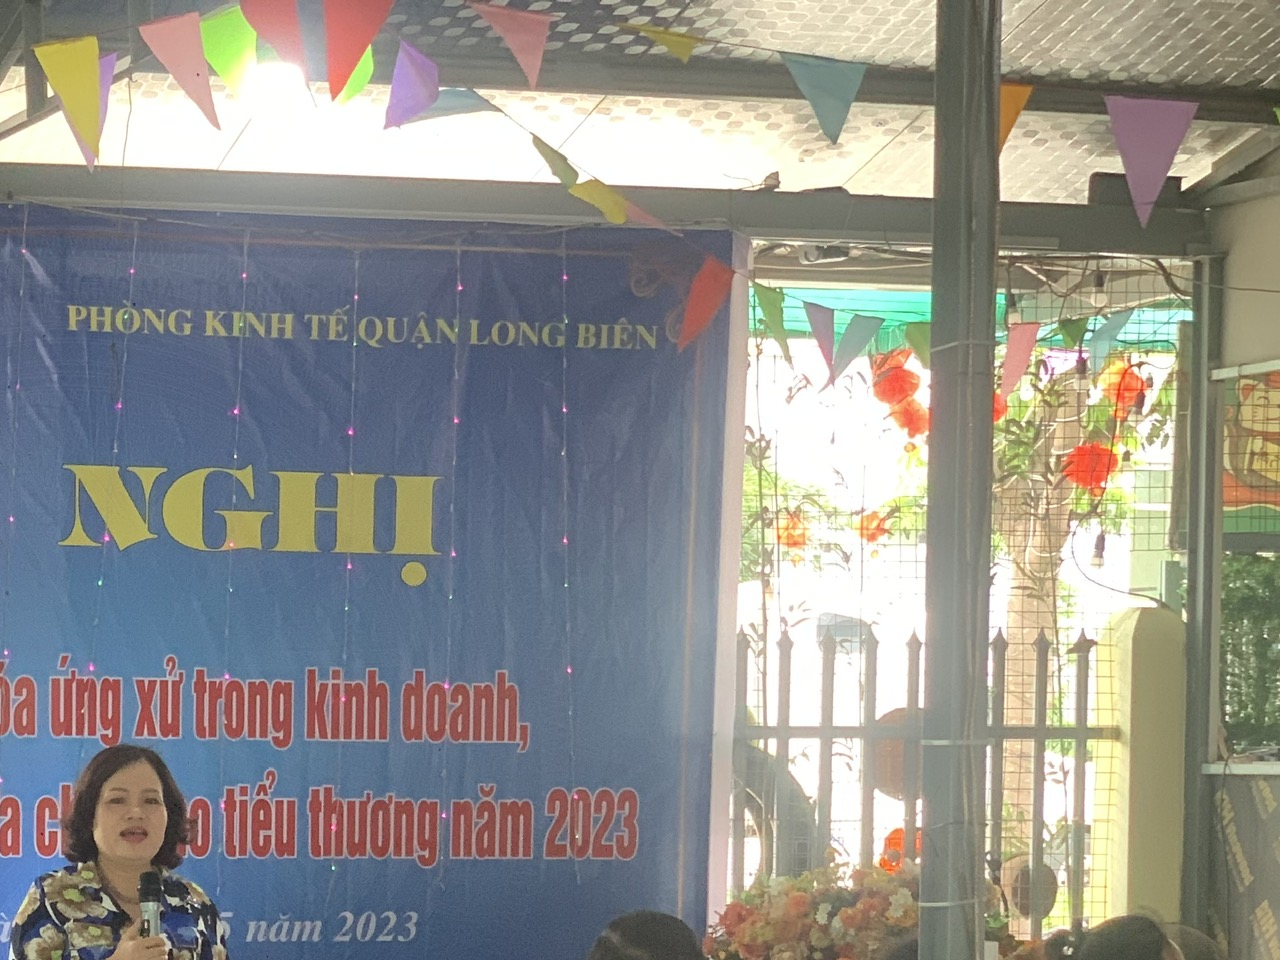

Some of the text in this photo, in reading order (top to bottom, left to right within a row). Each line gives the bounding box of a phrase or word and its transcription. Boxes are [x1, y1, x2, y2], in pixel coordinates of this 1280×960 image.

[67, 302, 658, 350] PHÒNG KINH TẾ QUẬN LONG BIÊN
[58, 464, 445, 587] NGHỊ
[50, 653, 122, 747] ứng
[134, 654, 184, 740] xử
[193, 668, 294, 749] trong
[305, 666, 390, 742] kinh
[402, 669, 531, 752] doanh,
[223, 768, 298, 860] tiểu
[308, 785, 439, 869] thương
[449, 784, 534, 861] năm
[544, 786, 639, 862] 2023
[245, 912, 324, 945] năm
[334, 910, 419, 944] 2023
